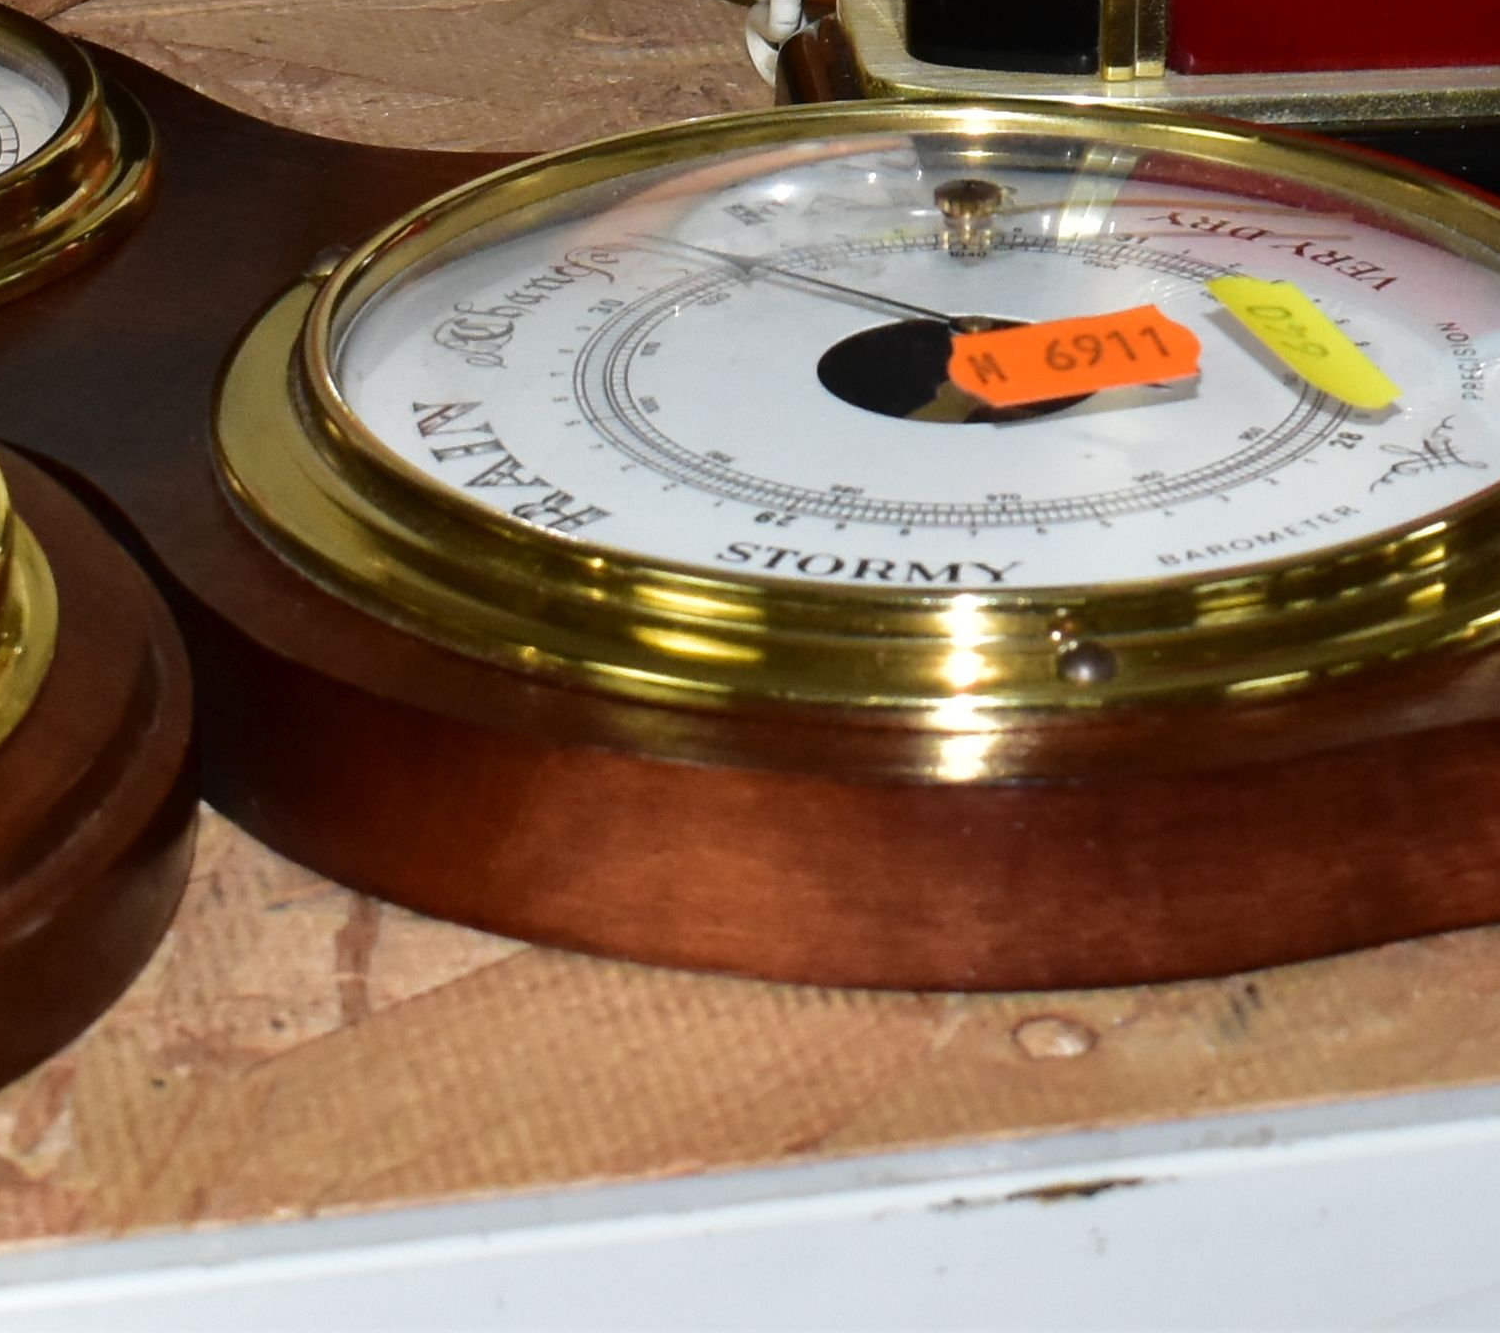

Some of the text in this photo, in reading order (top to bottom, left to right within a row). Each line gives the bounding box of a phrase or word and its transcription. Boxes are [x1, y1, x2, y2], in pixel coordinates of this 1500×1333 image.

[1143, 210, 1398, 291] VERY DRY
[433, 246, 619, 368] Change
[1044, 324, 1174, 375] 6911
[1436, 321, 1485, 401] PRECISION
[412, 401, 612, 532] RAIN
[716, 540, 1024, 583] STORMY
[1157, 503, 1361, 566] BAROMETER
